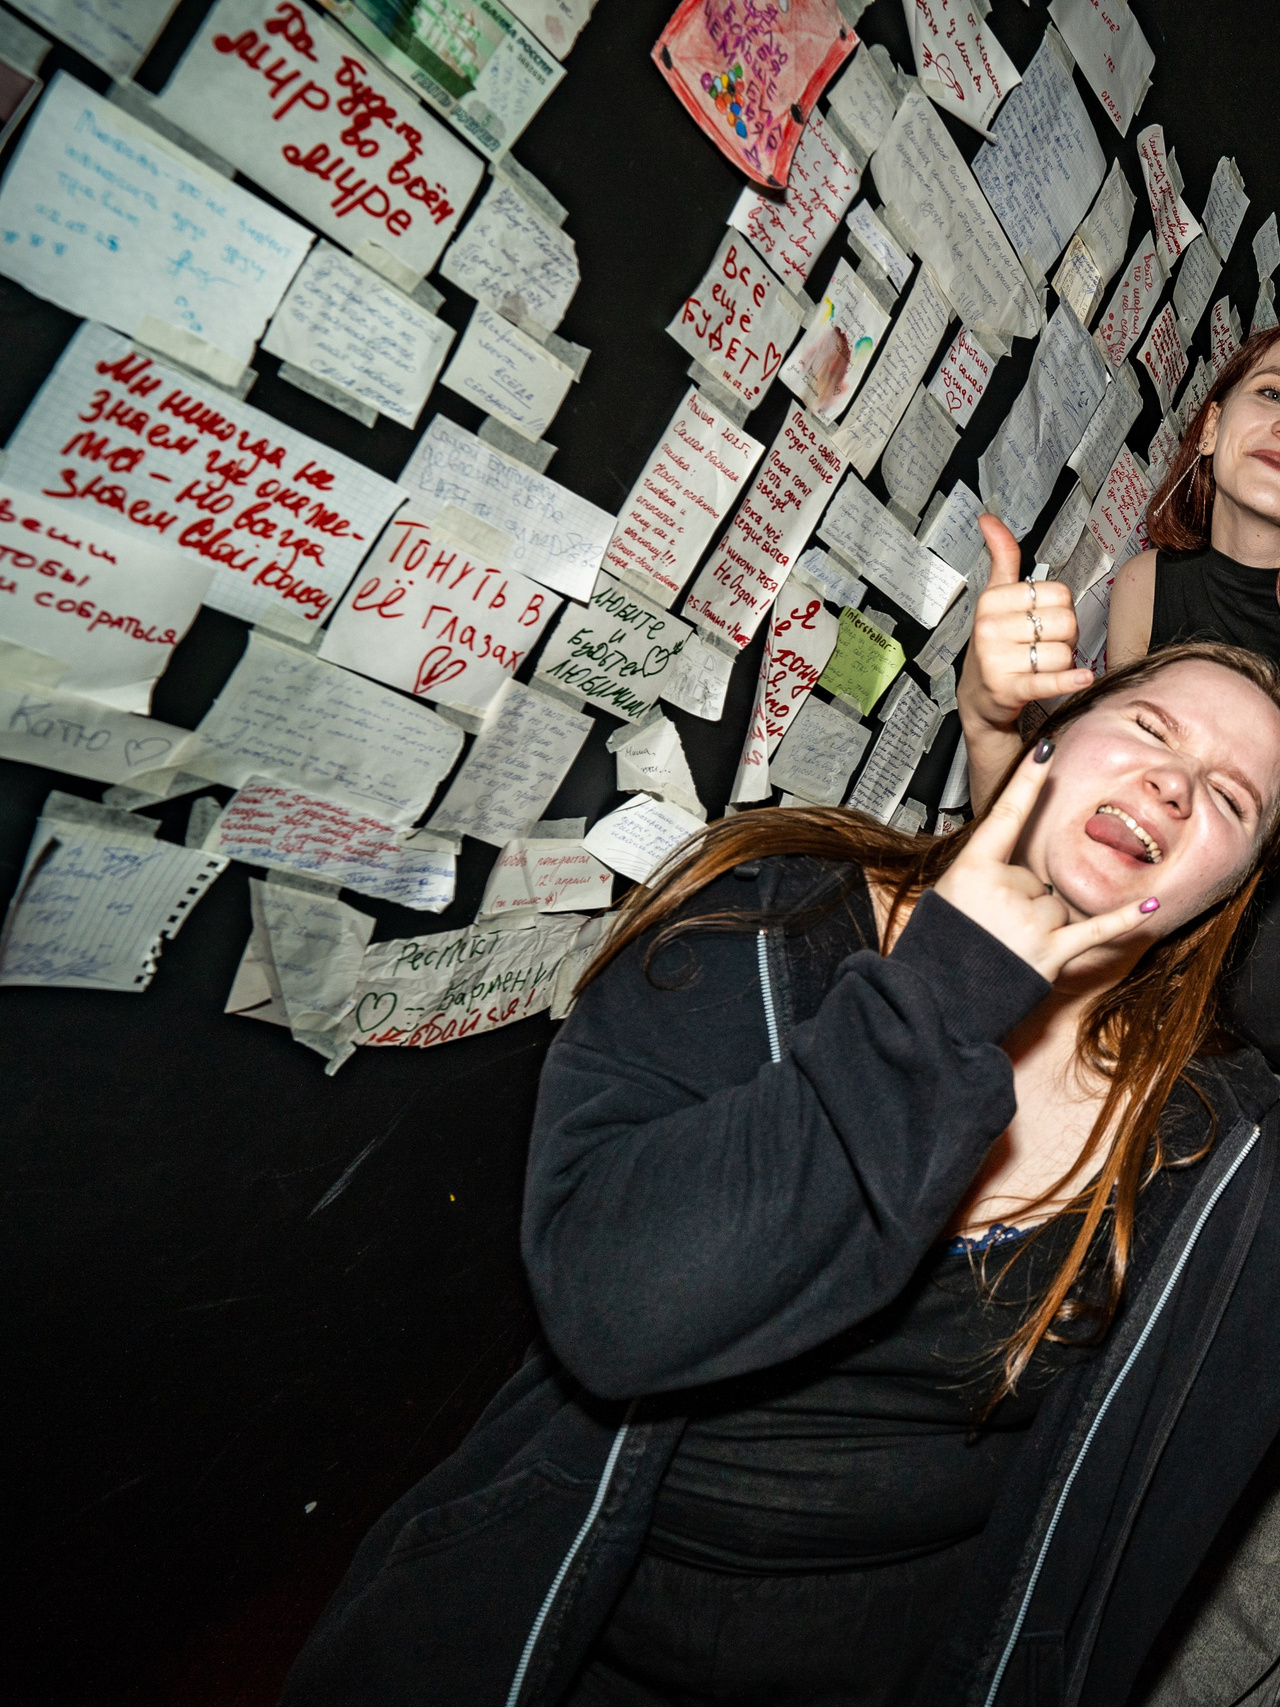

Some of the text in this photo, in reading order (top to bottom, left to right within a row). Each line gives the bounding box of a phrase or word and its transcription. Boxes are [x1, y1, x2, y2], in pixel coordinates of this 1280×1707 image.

[264, 1, 319, 63] Да
[516, 37, 555, 77] РОССИИ
[680, 297, 760, 376] БУДЕТ
[957, 326, 989, 378] Кристина
[791, 410, 818, 447] Пока
[768, 448, 792, 478] Пока
[713, 557, 733, 588] Не
[352, 577, 415, 619] её
[790, 600, 822, 630] Я
